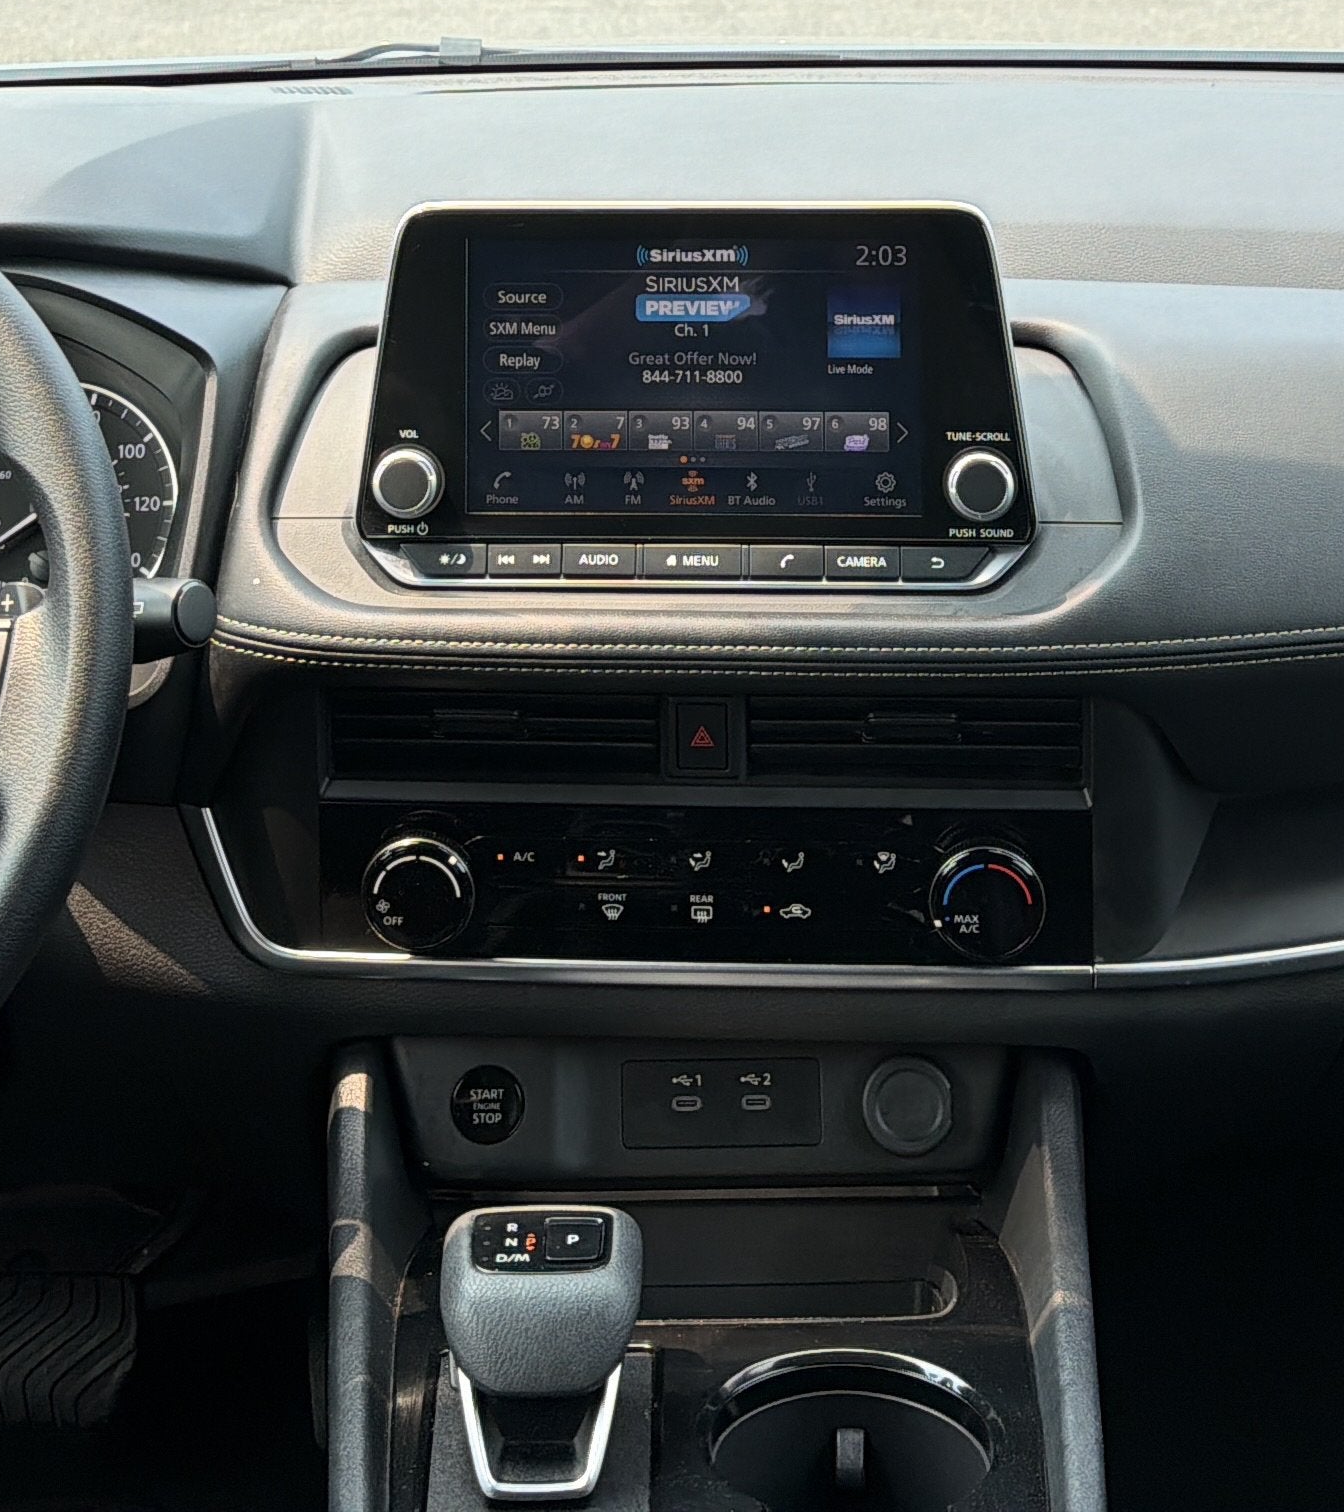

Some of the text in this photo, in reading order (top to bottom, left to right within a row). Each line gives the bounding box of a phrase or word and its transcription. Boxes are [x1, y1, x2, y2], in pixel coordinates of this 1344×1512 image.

[856, 245, 907, 266] 2:03
[645, 275, 739, 292] SIRIUSXM
[497, 290, 547, 304] Source
[645, 300, 740, 316] PREVIEW
[834, 314, 895, 326] SiriusXM
[489, 322, 556, 336] SXM Menu
[674, 323, 709, 338] Ch. 1
[499, 353, 541, 370] Replay
[628, 351, 757, 366] Great Offer Now!
[827, 364, 874, 374] Live Mode
[642, 370, 743, 384] 844-711-8800
[542, 417, 560, 428] 73
[616, 417, 625, 428] 7
[672, 418, 690, 429] 93
[700, 418, 708, 428] 4
[737, 418, 756, 430] 94
[766, 418, 774, 429] 5
[802, 418, 821, 430] 97
[832, 418, 840, 429] 6
[868, 418, 888, 431] 98
[399, 428, 419, 439] VOL
[118, 444, 146, 459] 100
[0, 470, 12, 480] 60
[134, 496, 160, 512] 120
[486, 494, 519, 506] Phone
[564, 494, 584, 505] AM
[625, 494, 642, 505] FM
[669, 494, 716, 506] SiriusXM
[728, 495, 776, 506] BT Audio
[797, 496, 824, 506] USB1
[863, 496, 906, 508] Settings
[388, 524, 414, 534] PUSH
[949, 528, 1014, 538] PUSH SOUND
[578, 554, 619, 566] AUDIO
[682, 556, 720, 568] MENU
[836, 556, 887, 568] CAMERA
[512, 850, 536, 863] A/C
[598, 893, 627, 902] FRONT
[689, 894, 714, 904] REAR
[382, 916, 404, 926] OFF
[953, 914, 980, 924] MAX
[959, 924, 980, 934] A/C
[762, 1072, 772, 1086] 2
[470, 1088, 504, 1100] START
[472, 1102, 502, 1110] ENGINE
[472, 1112, 502, 1125] STOP
[506, 1222, 518, 1233] R
[505, 1237, 518, 1247] N
[566, 1234, 580, 1246] P
[495, 1252, 531, 1264] D/M
